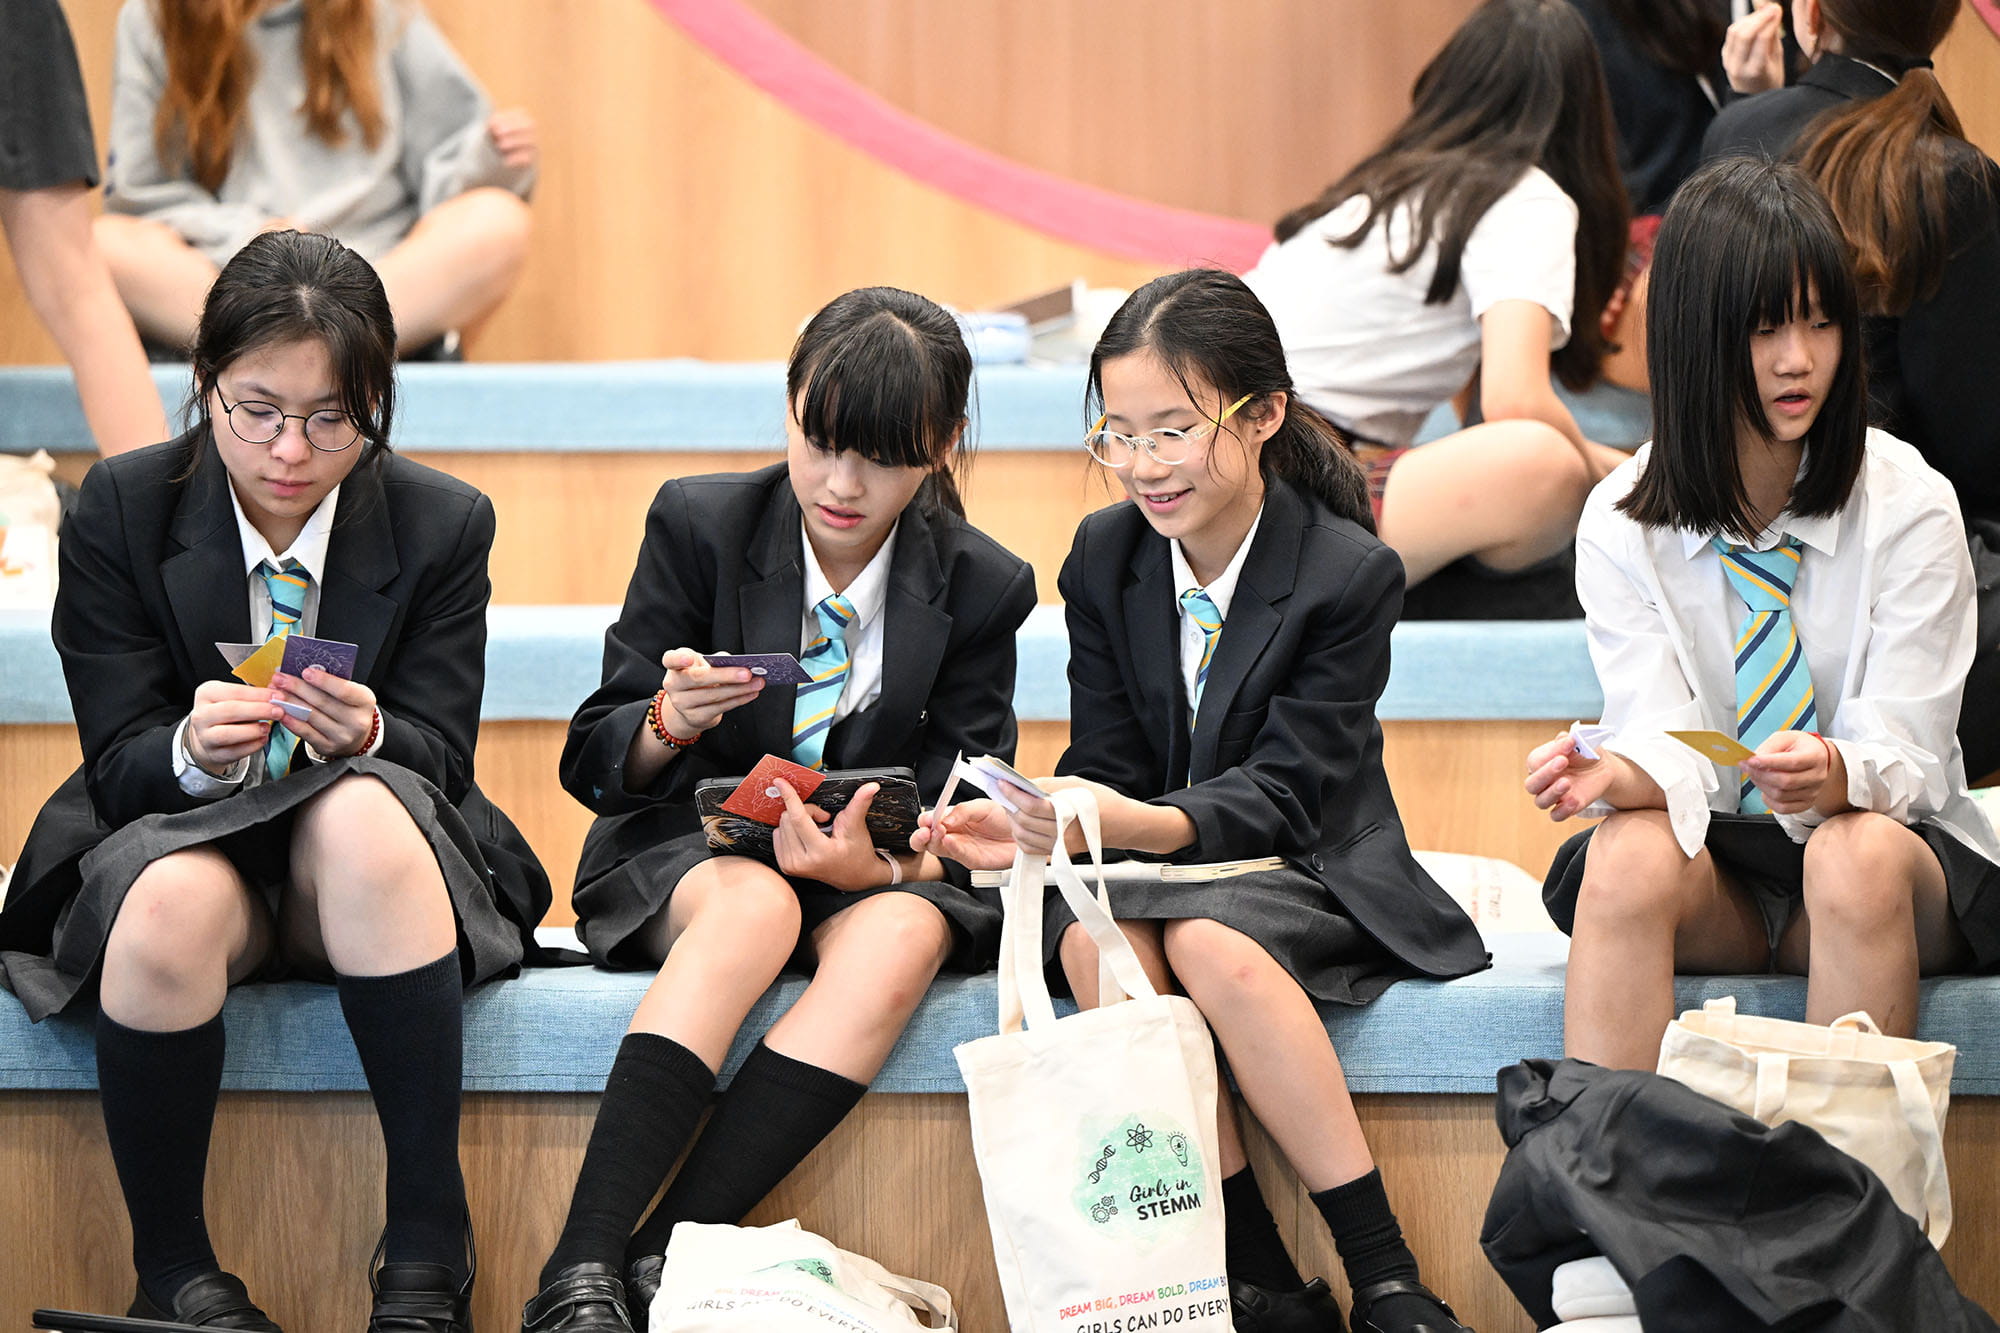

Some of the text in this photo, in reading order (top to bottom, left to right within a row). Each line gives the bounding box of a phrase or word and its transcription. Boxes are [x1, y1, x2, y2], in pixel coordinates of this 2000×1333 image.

[1129, 1179, 1192, 1203] Girls in
[1137, 1193, 1201, 1220] STEMM
[1059, 1302, 1092, 1320] DREAM
[1094, 1297, 1118, 1311] BIG,
[1118, 1290, 1155, 1306] DREAM
[1157, 1284, 1188, 1299] BOLD,
[1188, 1277, 1219, 1293] DREAM
[1127, 1312, 1158, 1332] CAN
[1163, 1307, 1183, 1325] DO
